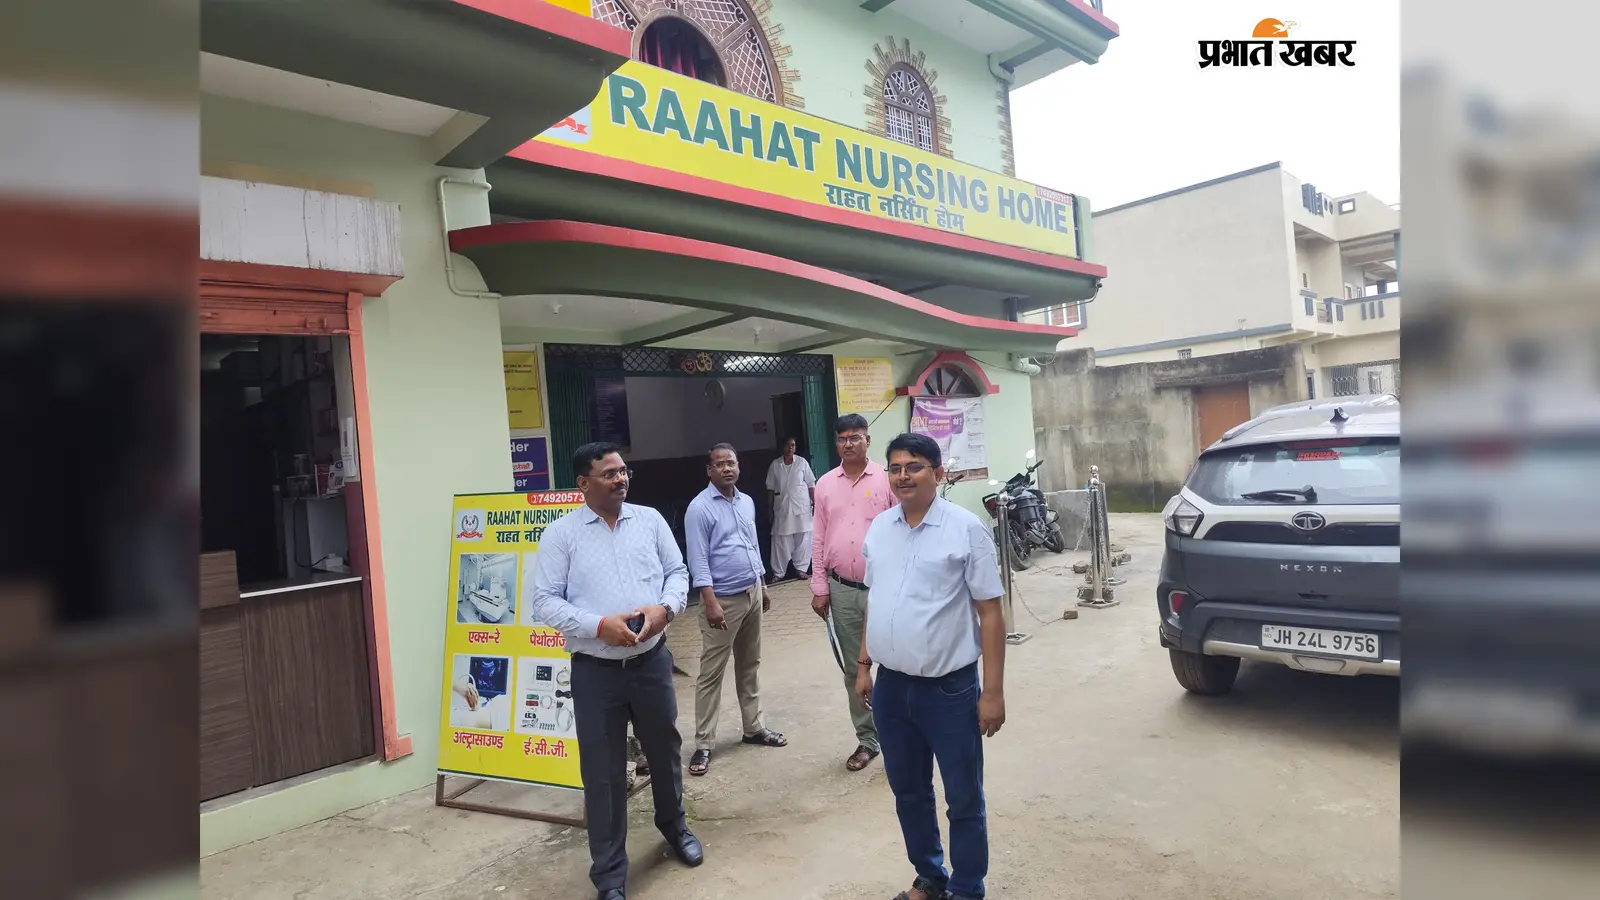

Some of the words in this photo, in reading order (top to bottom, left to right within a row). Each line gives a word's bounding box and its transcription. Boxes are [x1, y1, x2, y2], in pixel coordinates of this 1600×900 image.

[608, 73, 821, 172] RAAHAT
[836, 138, 989, 214] NURSING
[997, 185, 1068, 235] HOME
[823, 183, 871, 212] राहत
[878, 193, 929, 224] नर्सिंग
[934, 202, 965, 232] होम
[487, 510, 521, 526] RAAHAT
[523, 508, 564, 525] NURSING
[496, 530, 520, 543] राहत
[1280, 564, 1342, 573] NEXON
[468, 628, 501, 644] एक्स-रे
[1273, 629, 1292, 645] JH
[1297, 631, 1327, 649] 24L
[1333, 634, 1376, 654] 9756
[453, 731, 504, 750] अल्ट्रासाउण्ड
[524, 737, 568, 758] ई.सी.जी.
